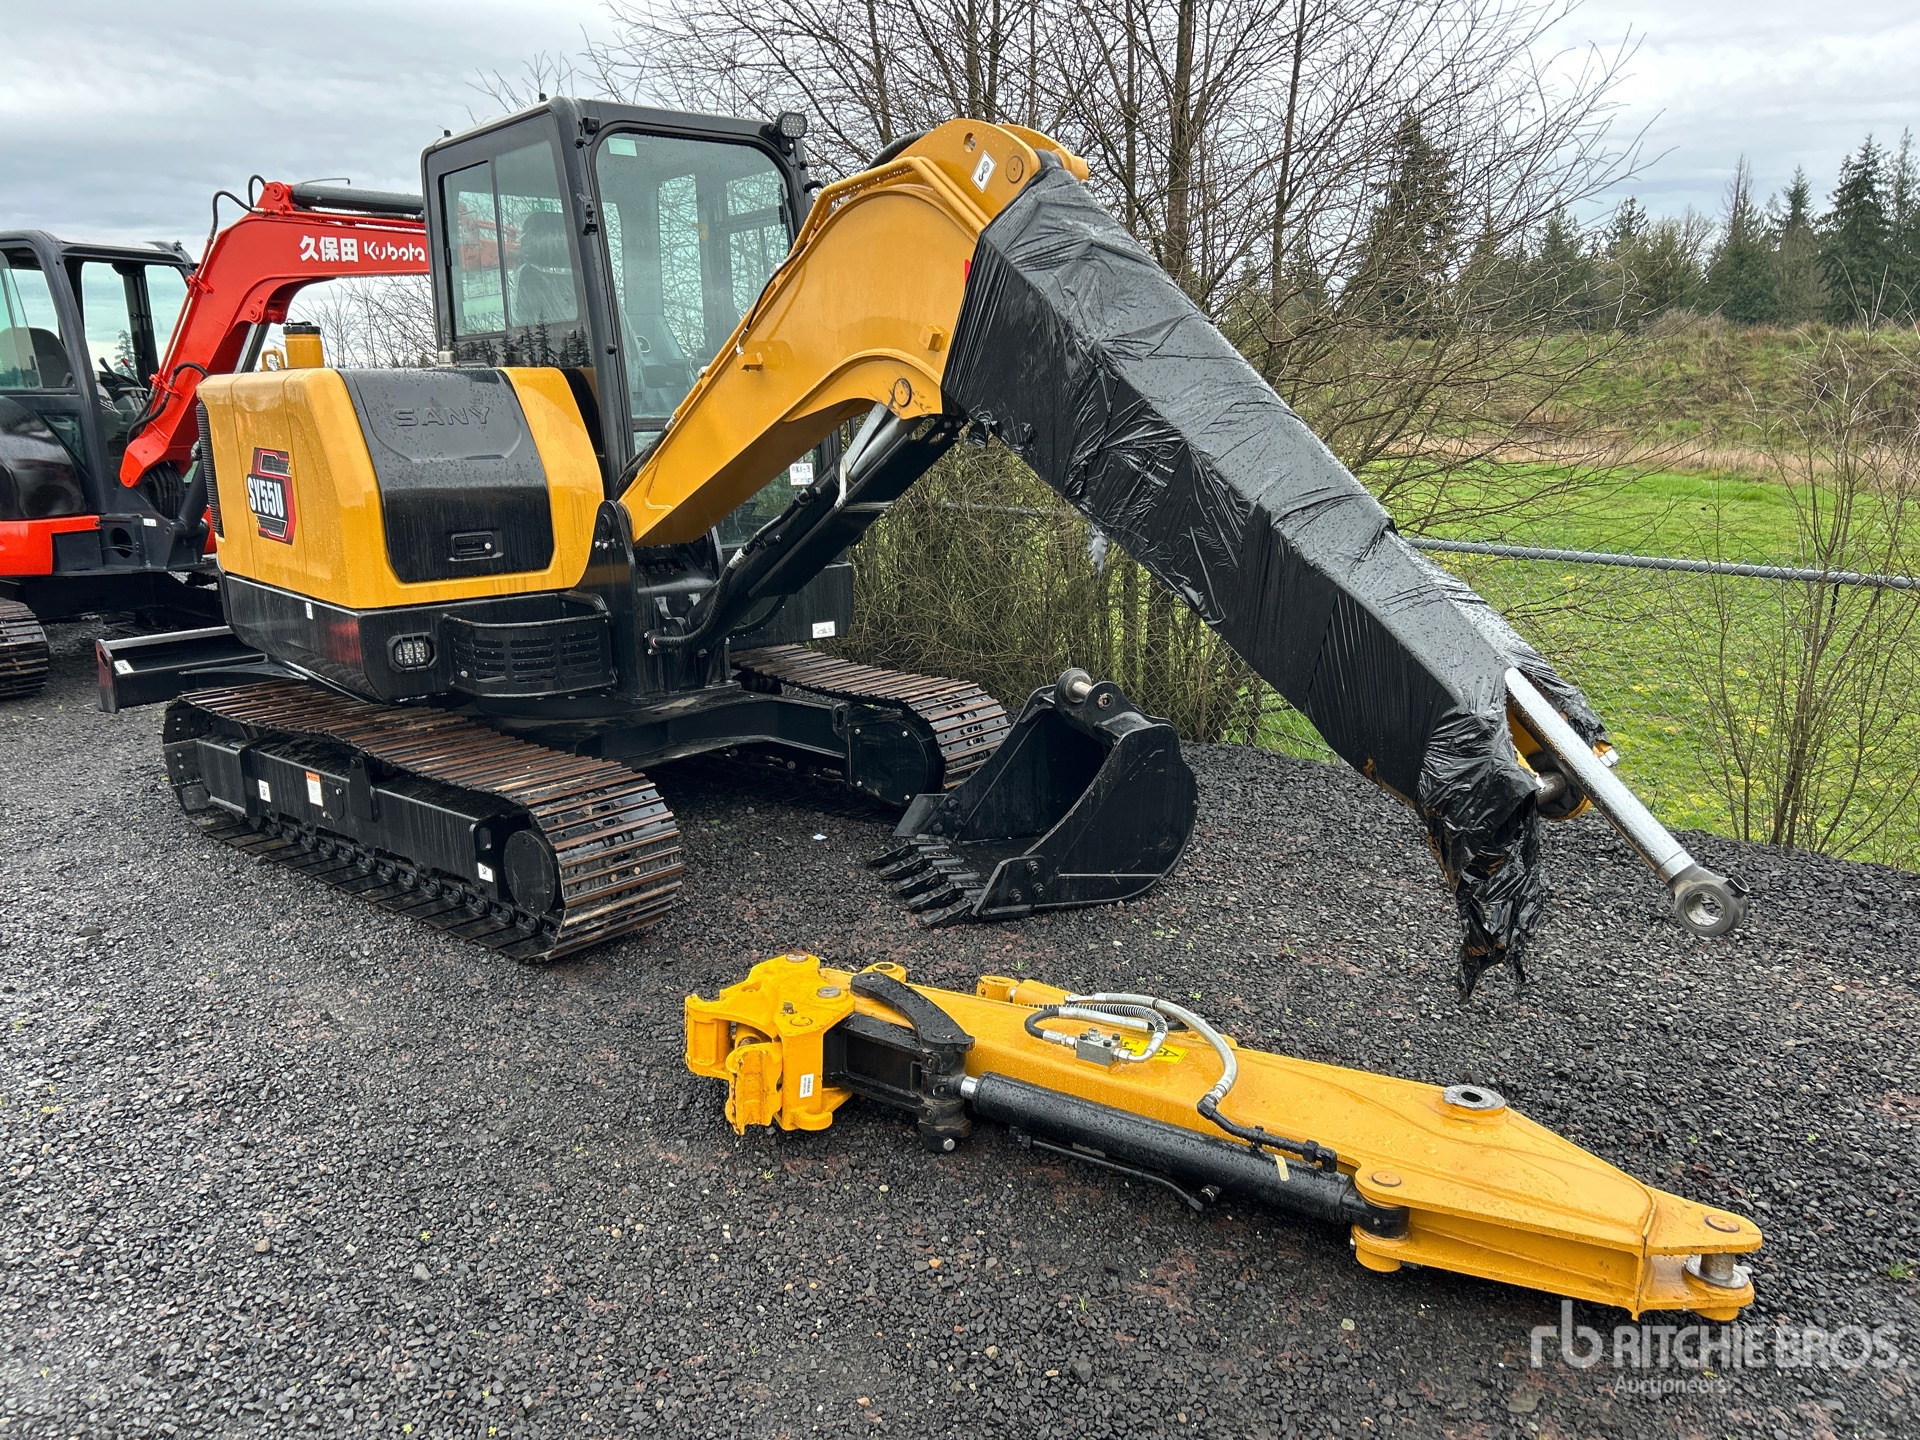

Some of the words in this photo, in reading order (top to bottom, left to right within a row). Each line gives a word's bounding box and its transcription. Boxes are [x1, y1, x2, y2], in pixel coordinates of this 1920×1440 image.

[299, 235, 359, 262] 久保田
[364, 241, 426, 262] Kubota
[393, 406, 490, 427] SANY
[247, 476, 284, 518] SY55U
